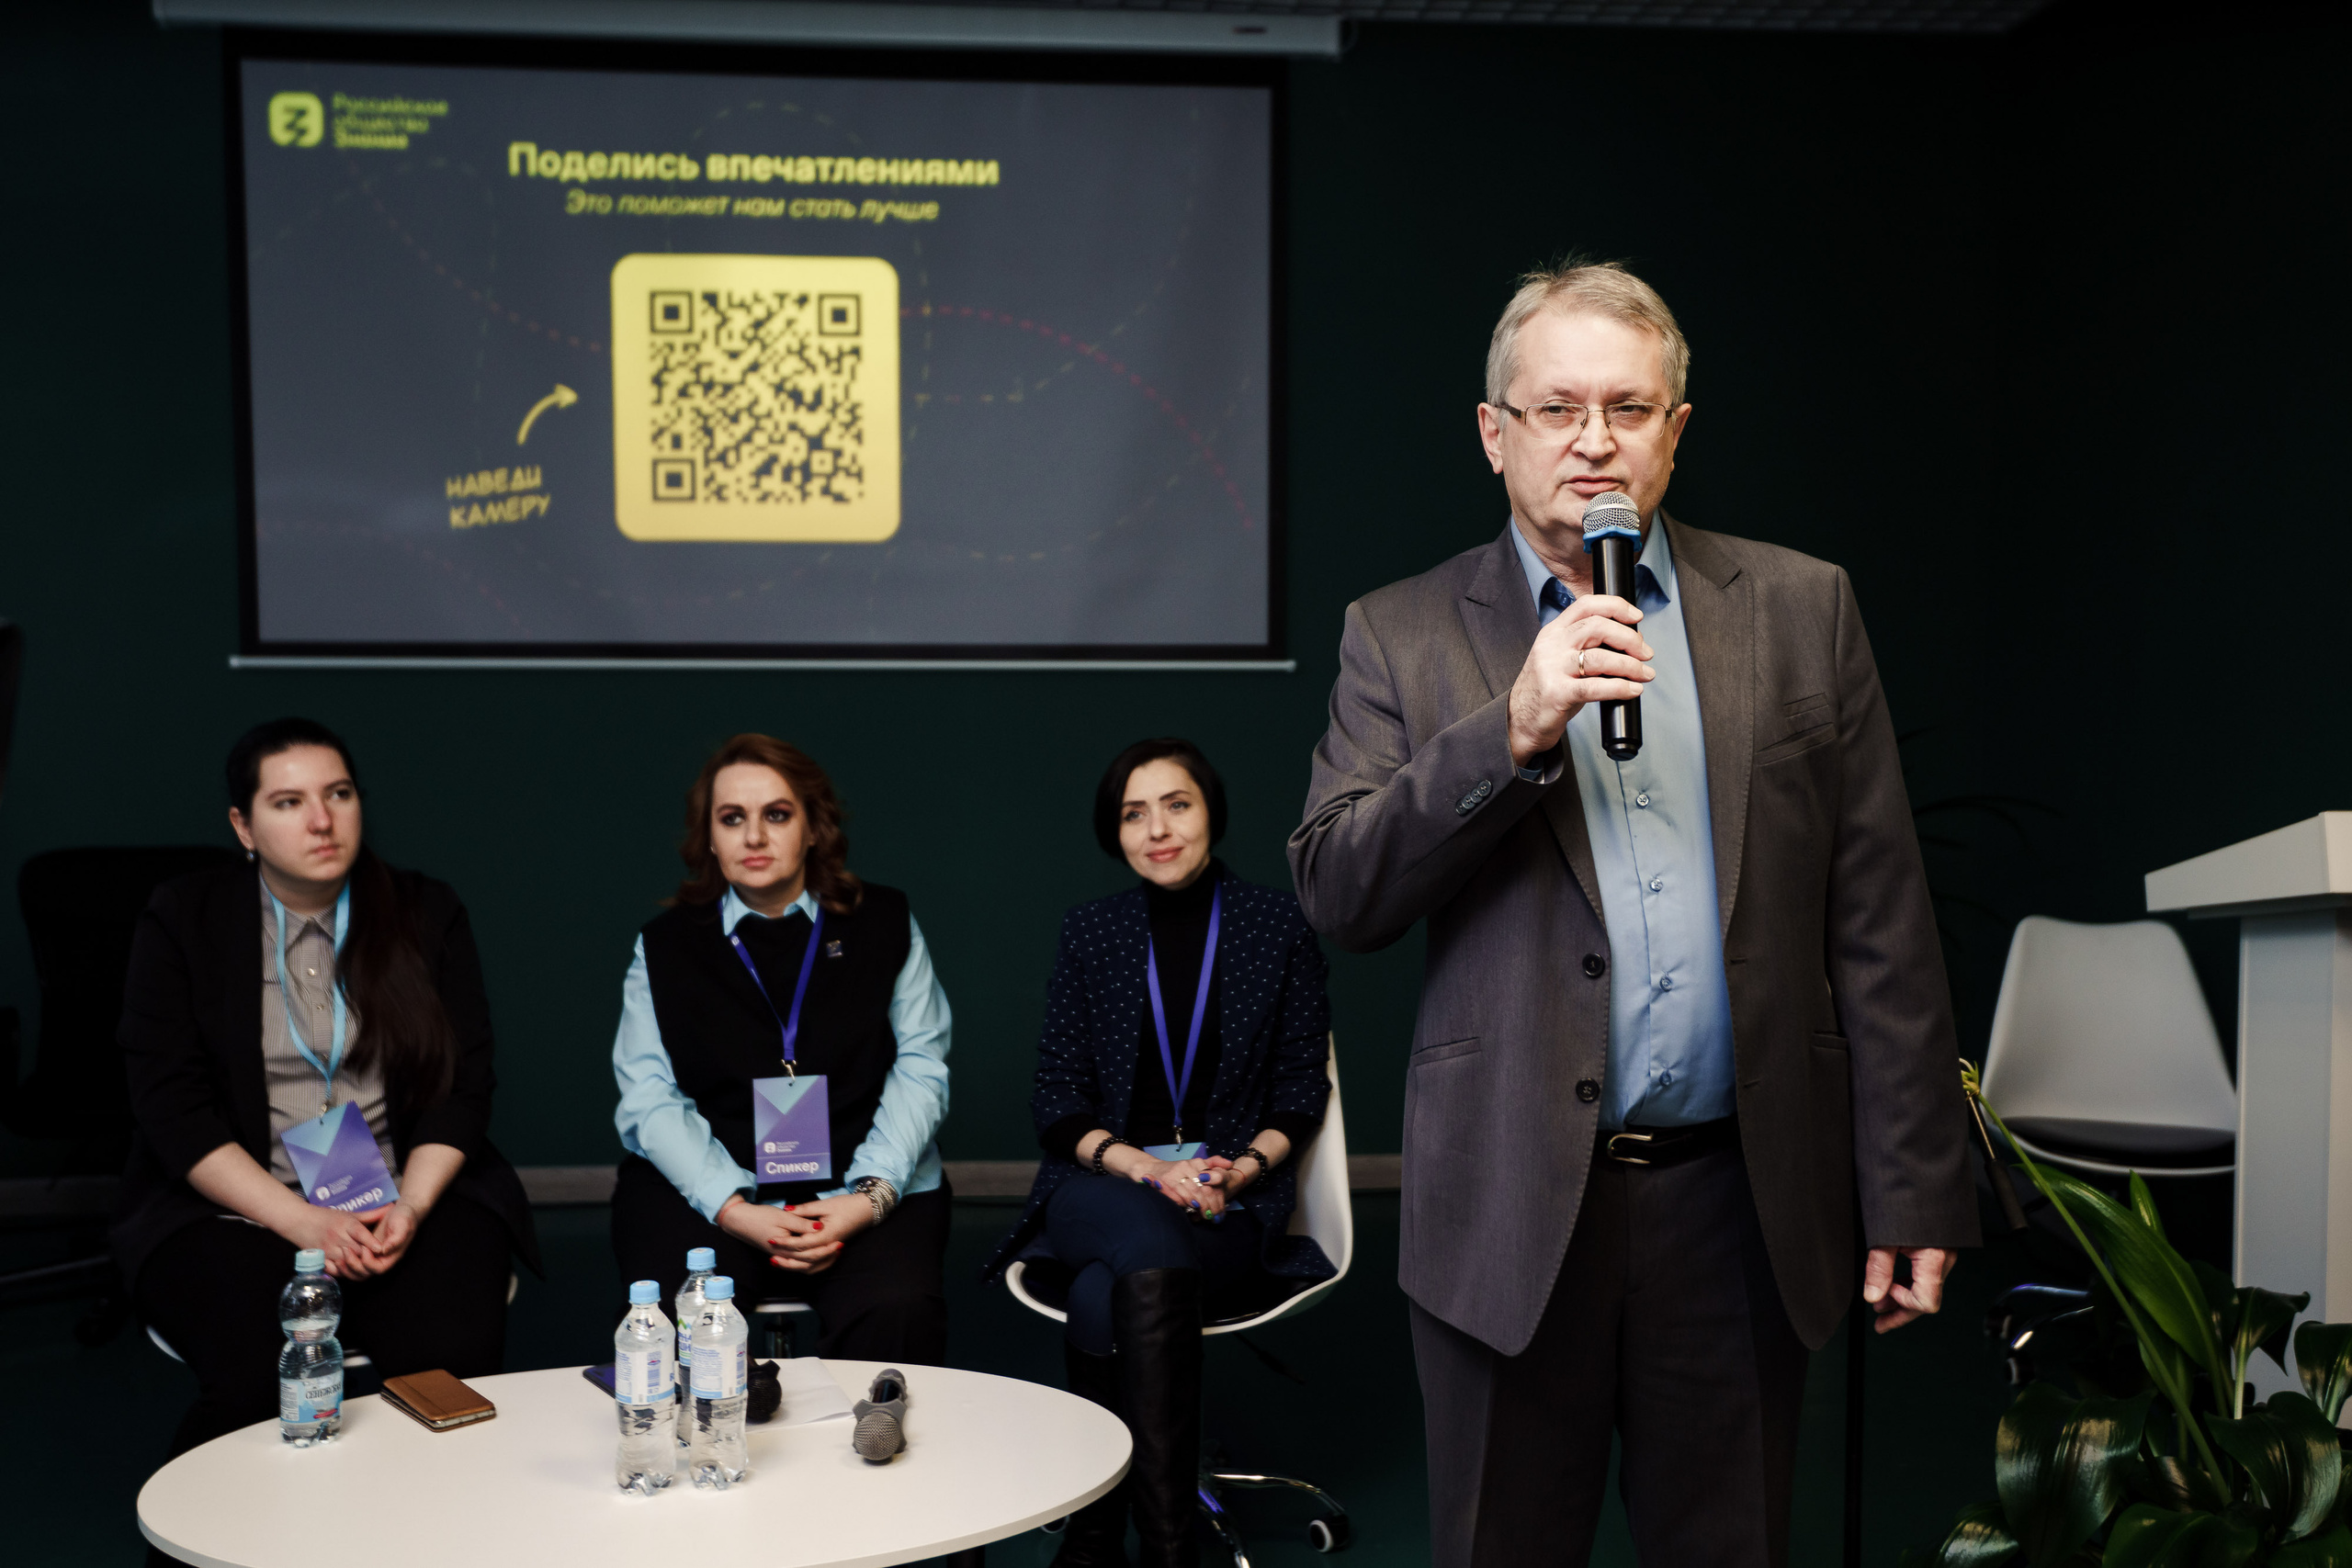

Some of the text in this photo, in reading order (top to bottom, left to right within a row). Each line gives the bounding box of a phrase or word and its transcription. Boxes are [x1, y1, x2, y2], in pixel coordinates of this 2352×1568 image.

[508, 141, 1000, 186] Поделись впечатлениями
[565, 189, 940, 224] Это поможет нам стать лучше
[446, 465, 542, 499] НАВЕДИ
[449, 493, 551, 529] КАМЕРУ
[765, 1161, 820, 1175] Спикер
[329, 1187, 383, 1212] пикер
